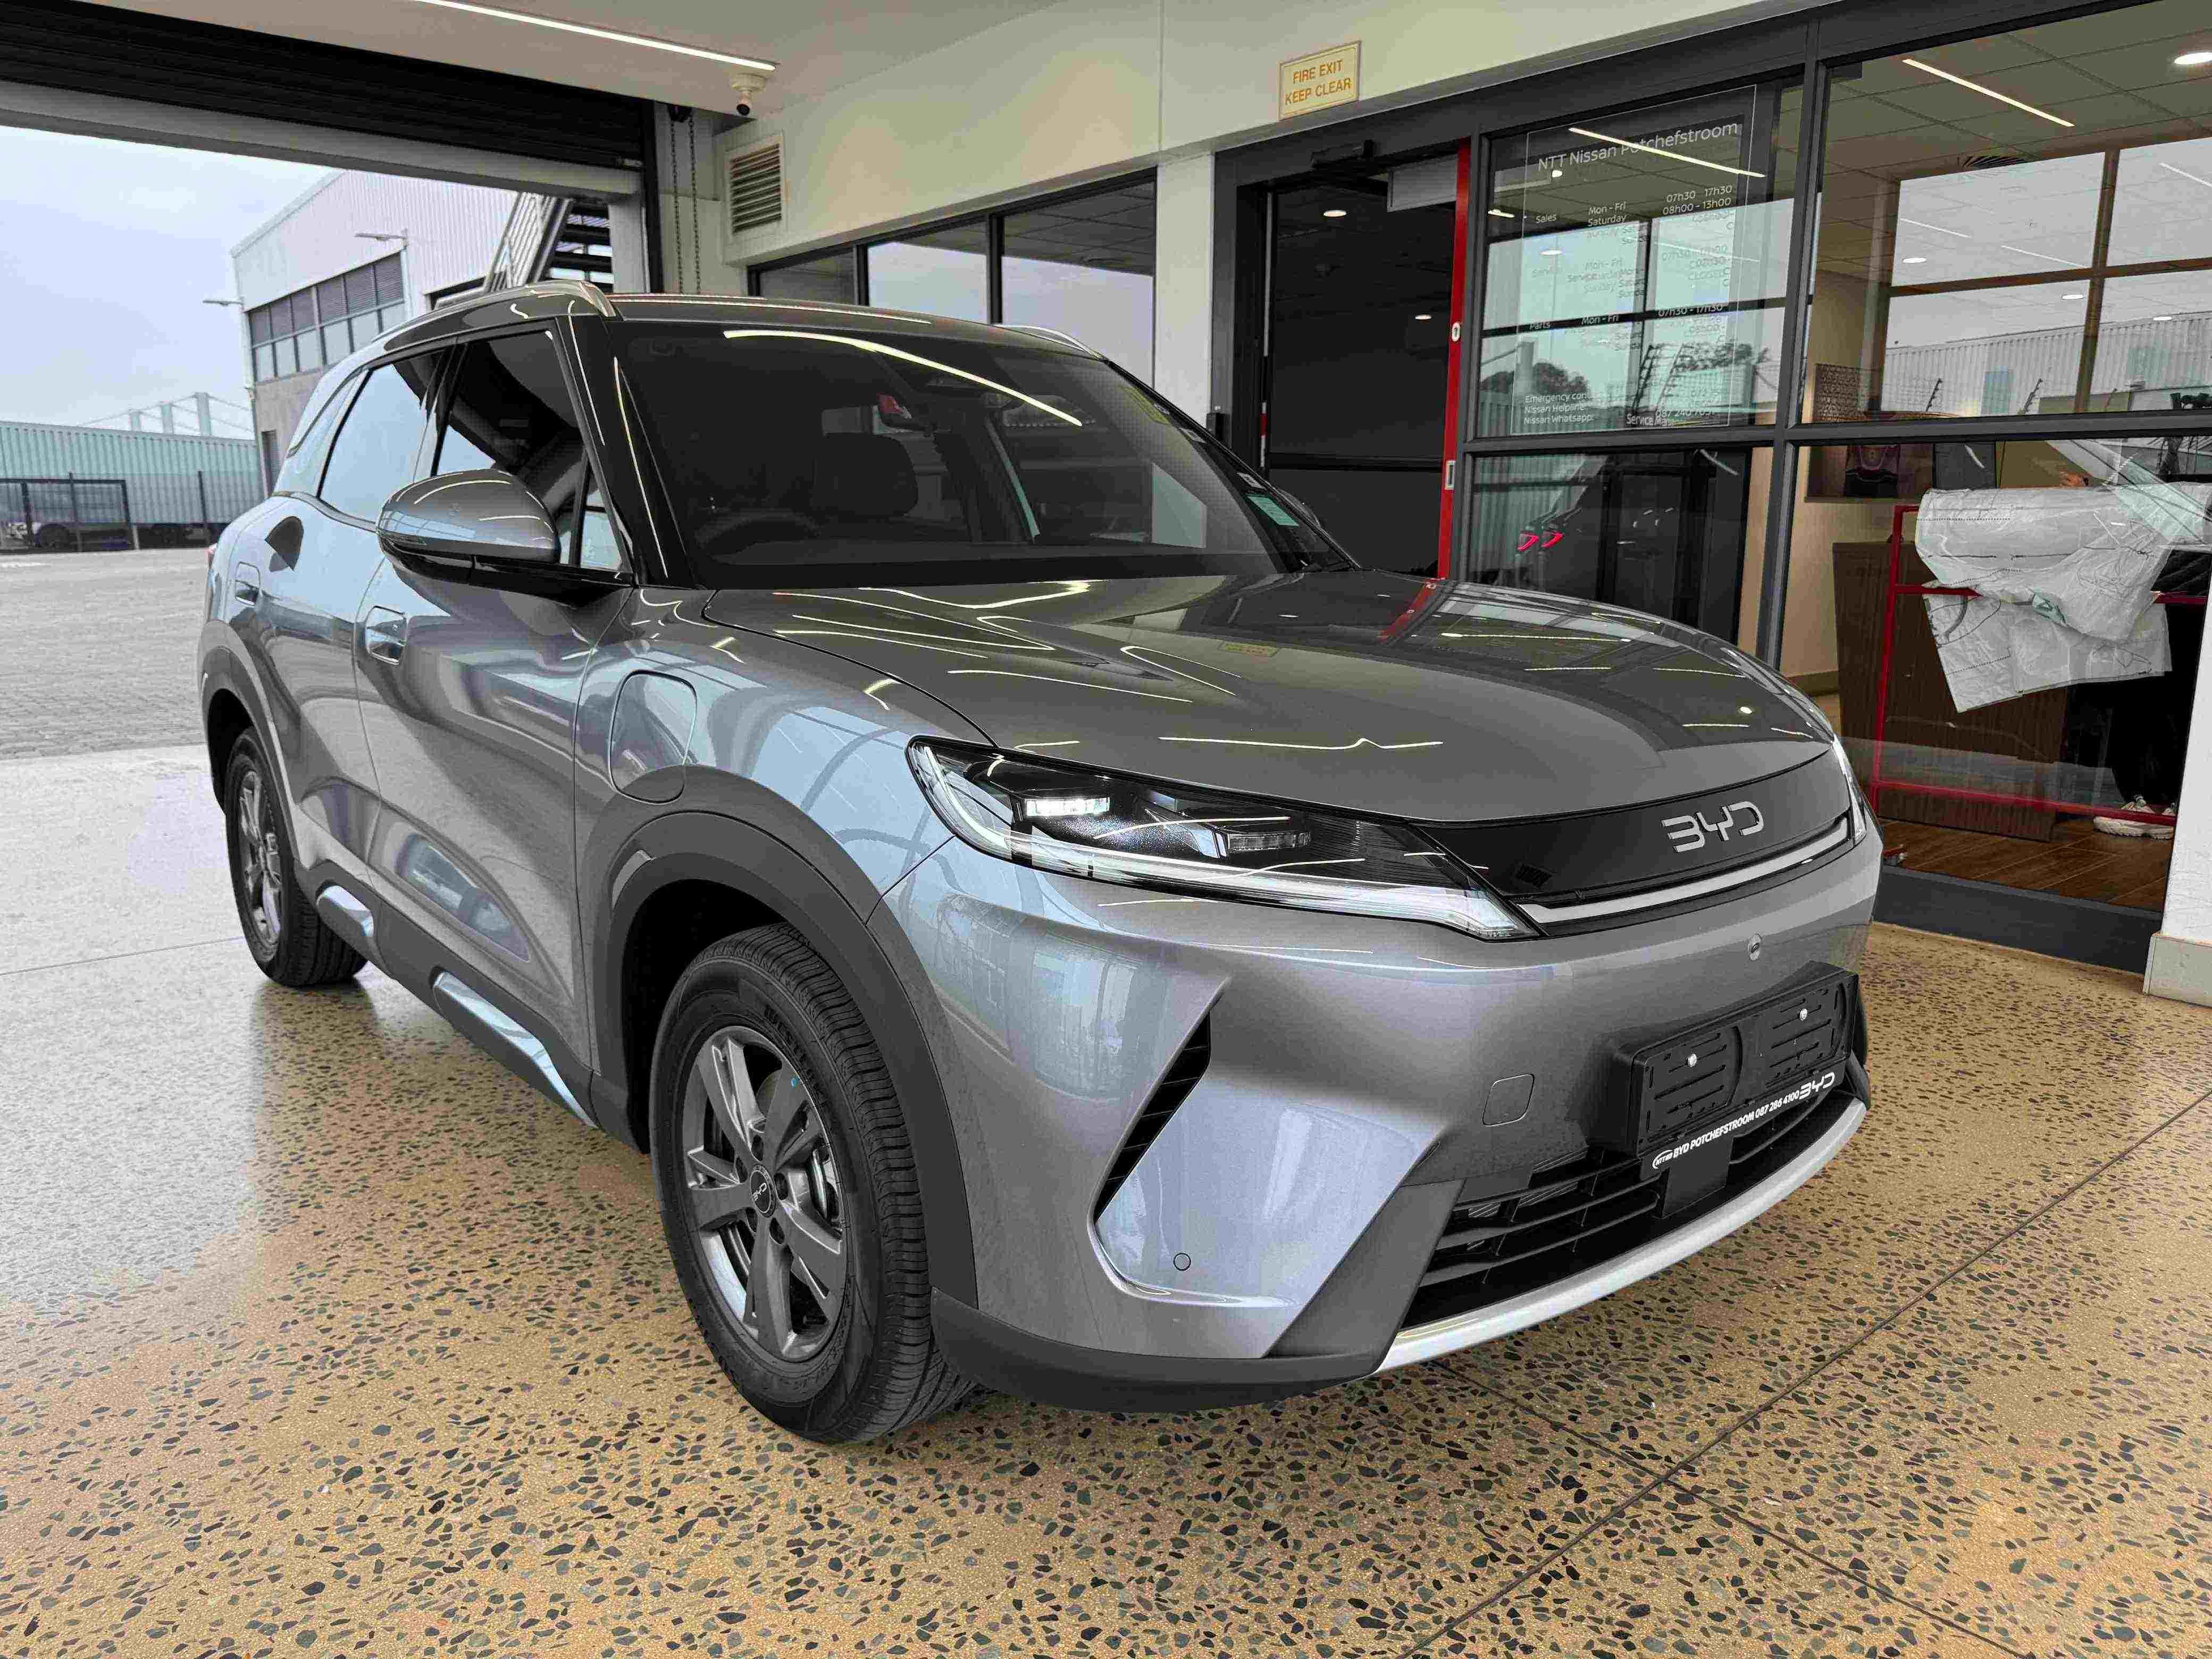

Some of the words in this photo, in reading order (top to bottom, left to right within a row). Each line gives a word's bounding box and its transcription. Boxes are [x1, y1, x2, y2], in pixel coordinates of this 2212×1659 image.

[1293, 67, 1316, 83] FIRE
[1319, 59, 1343, 77] EXIT
[1285, 89, 1311, 105] KEEP
[1315, 78, 1352, 97] CLEAR
[1538, 154, 1566, 172] NTT
[1570, 146, 1617, 165] Nissan
[1663, 203, 1694, 215] 08h00
[1702, 197, 1732, 209] 13h00
[1666, 190, 1696, 203] 07h30
[1704, 185, 1732, 197] 17h30
[1587, 215, 1627, 227] Saturday
[1588, 206, 1607, 215] Mon
[1661, 801, 1764, 852] BYD
[1673, 1143, 1689, 1158] BYD
[1690, 1111, 1755, 1150] POTCHEFSTROOM
[1755, 1104, 1770, 1118] 087
[1769, 1097, 1783, 1112] 286
[1783, 1090, 1800, 1104] 4100
[1799, 1072, 1834, 1100] BYD
